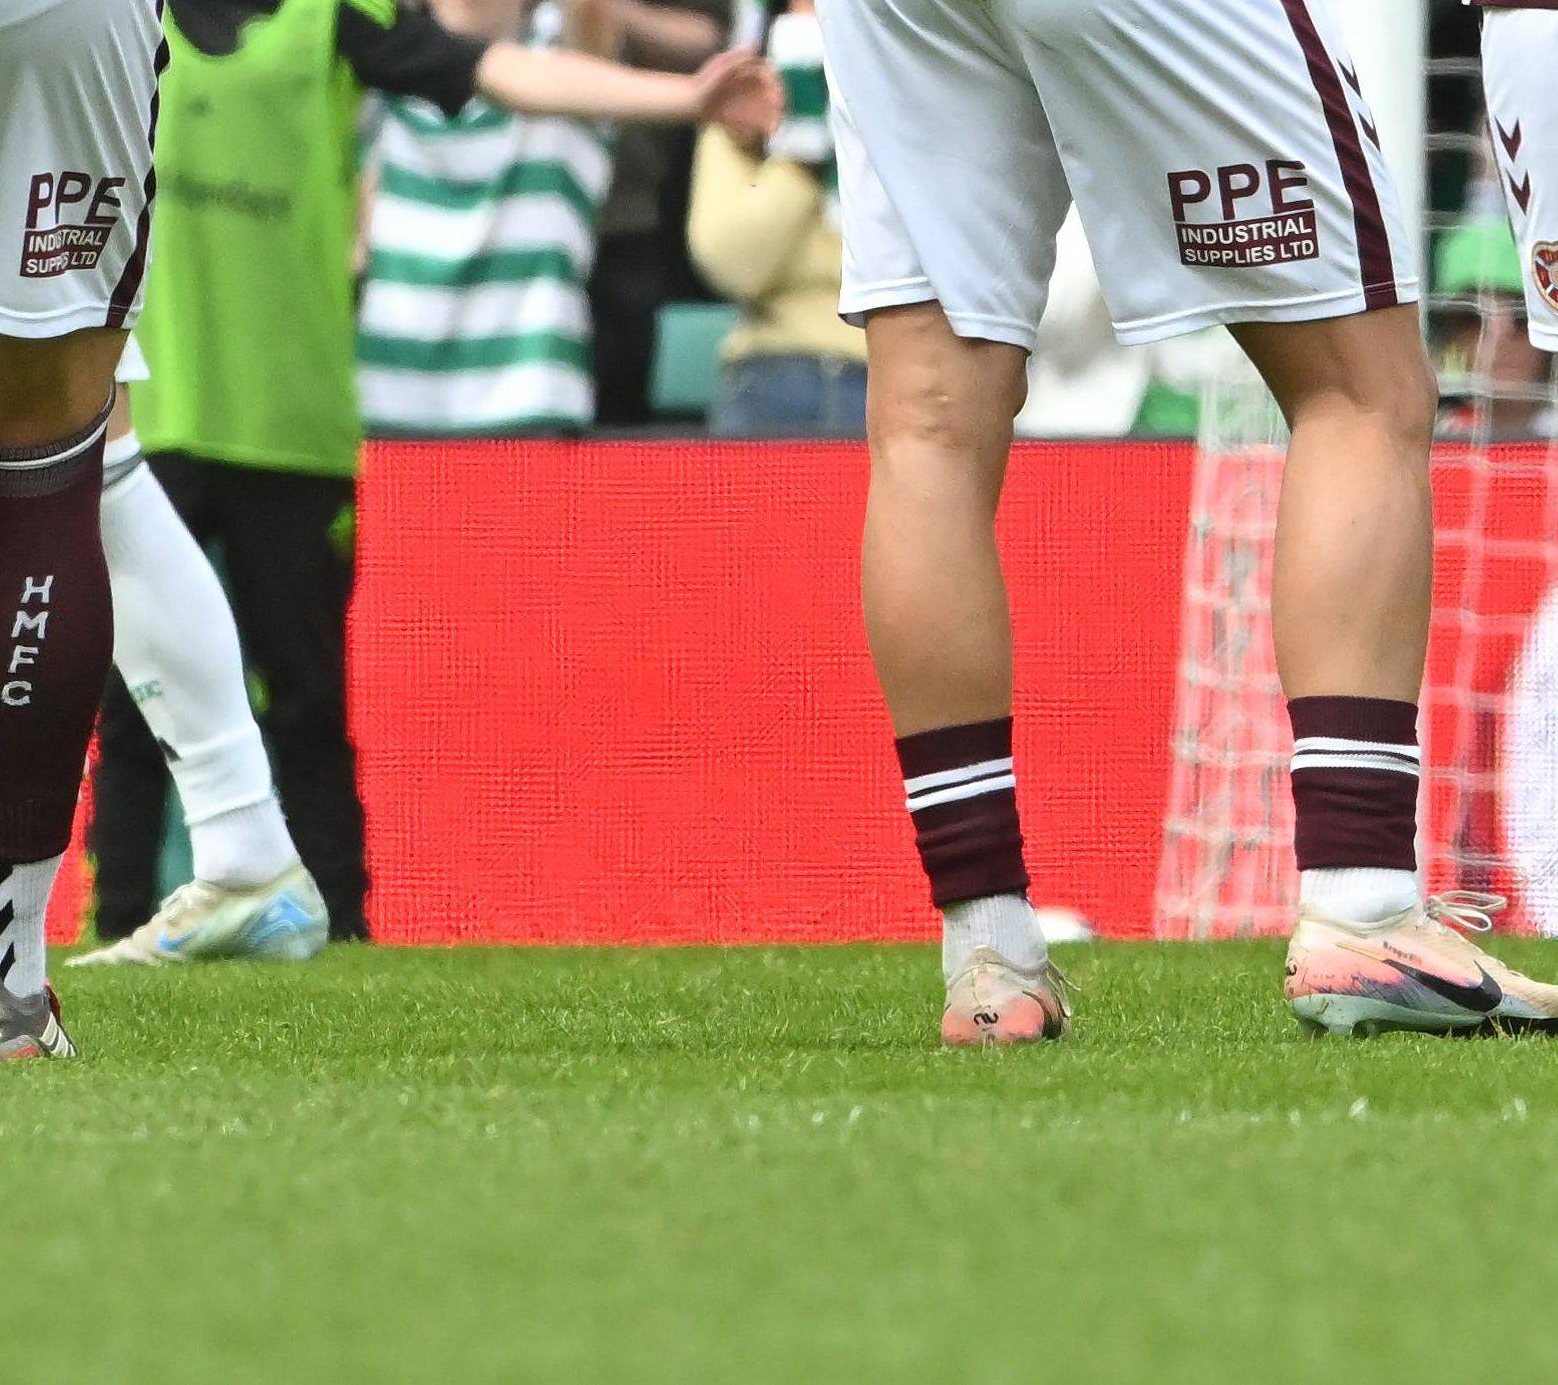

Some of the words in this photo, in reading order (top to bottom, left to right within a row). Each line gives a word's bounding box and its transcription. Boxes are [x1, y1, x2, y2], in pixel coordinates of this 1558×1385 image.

[25, 171, 126, 229] PPE
[1166, 159, 1315, 222] PPE
[1180, 215, 1313, 245] INDUSTRIAL
[70, 251, 97, 265] LTD
[1183, 242, 1277, 265] SUPPLIES
[1279, 239, 1316, 260] LTD
